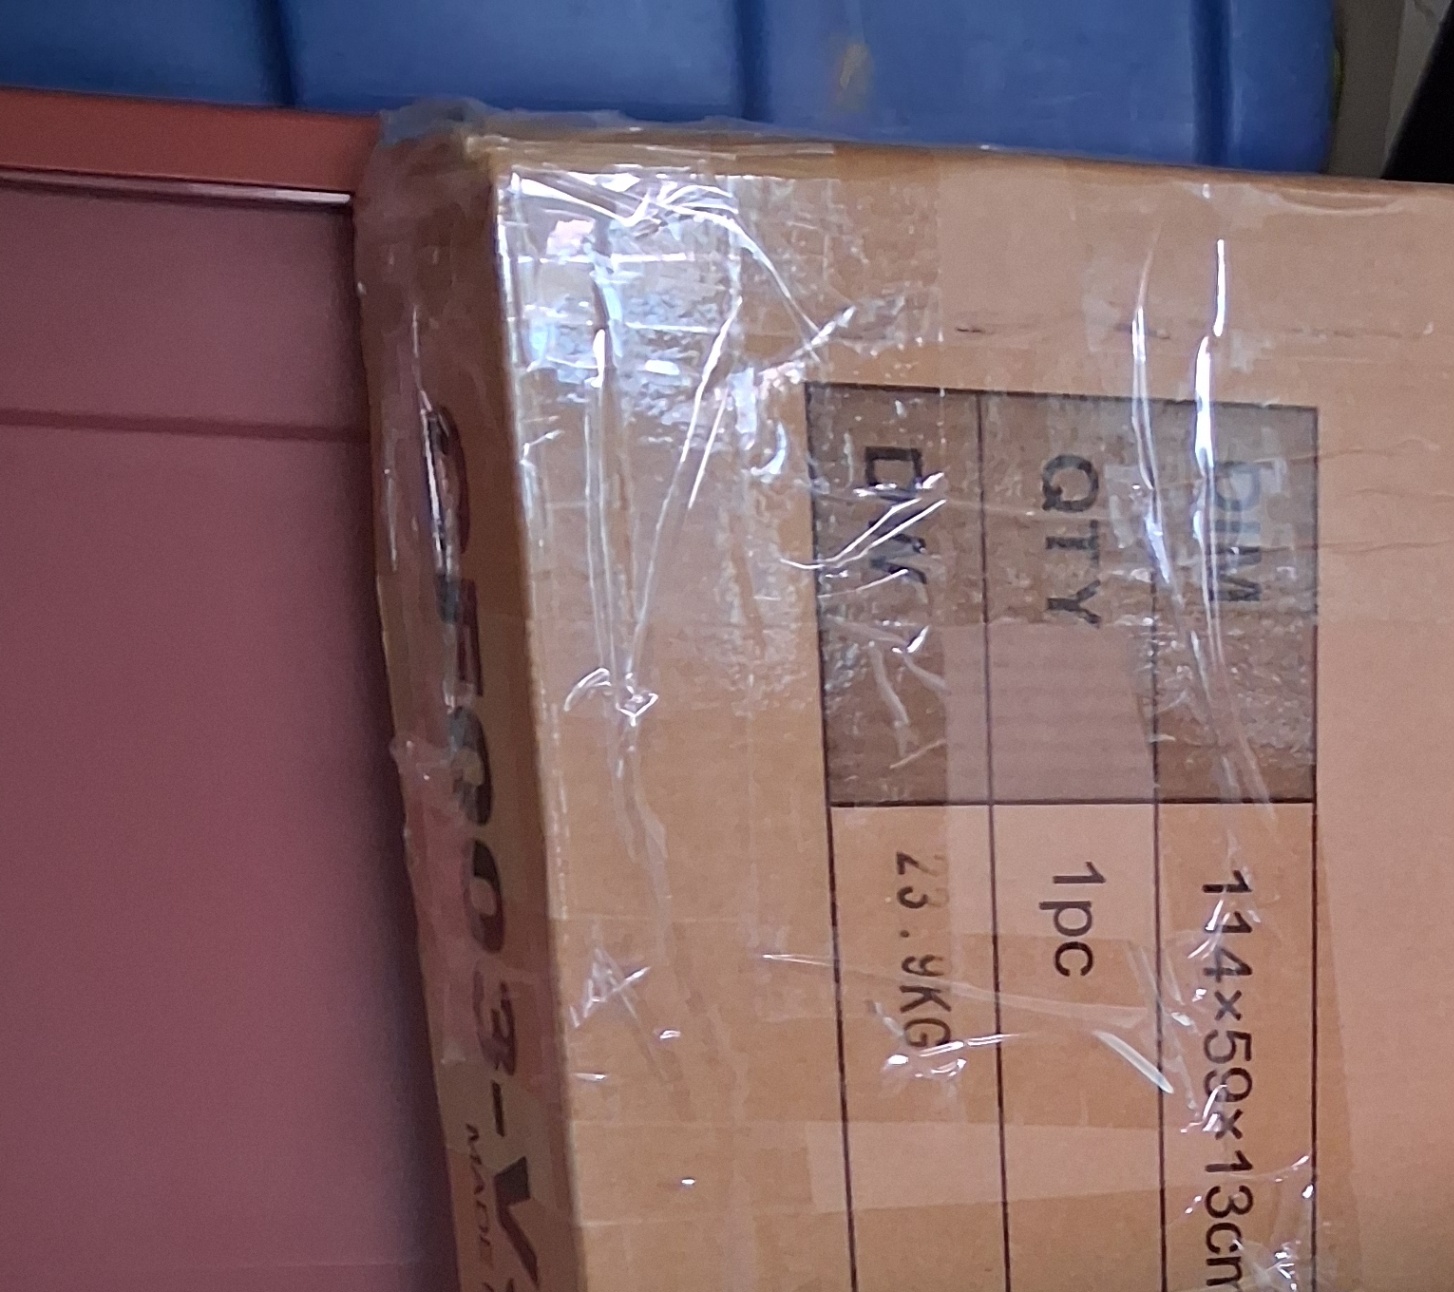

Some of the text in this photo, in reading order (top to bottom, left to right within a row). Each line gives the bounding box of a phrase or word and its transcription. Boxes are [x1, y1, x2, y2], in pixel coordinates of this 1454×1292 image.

[1041, 454, 1100, 628] QTY
[1207, 460, 1263, 602] DIM
[1039, 862, 1106, 977] 1pc
[464, 1122, 495, 1272] MADE
